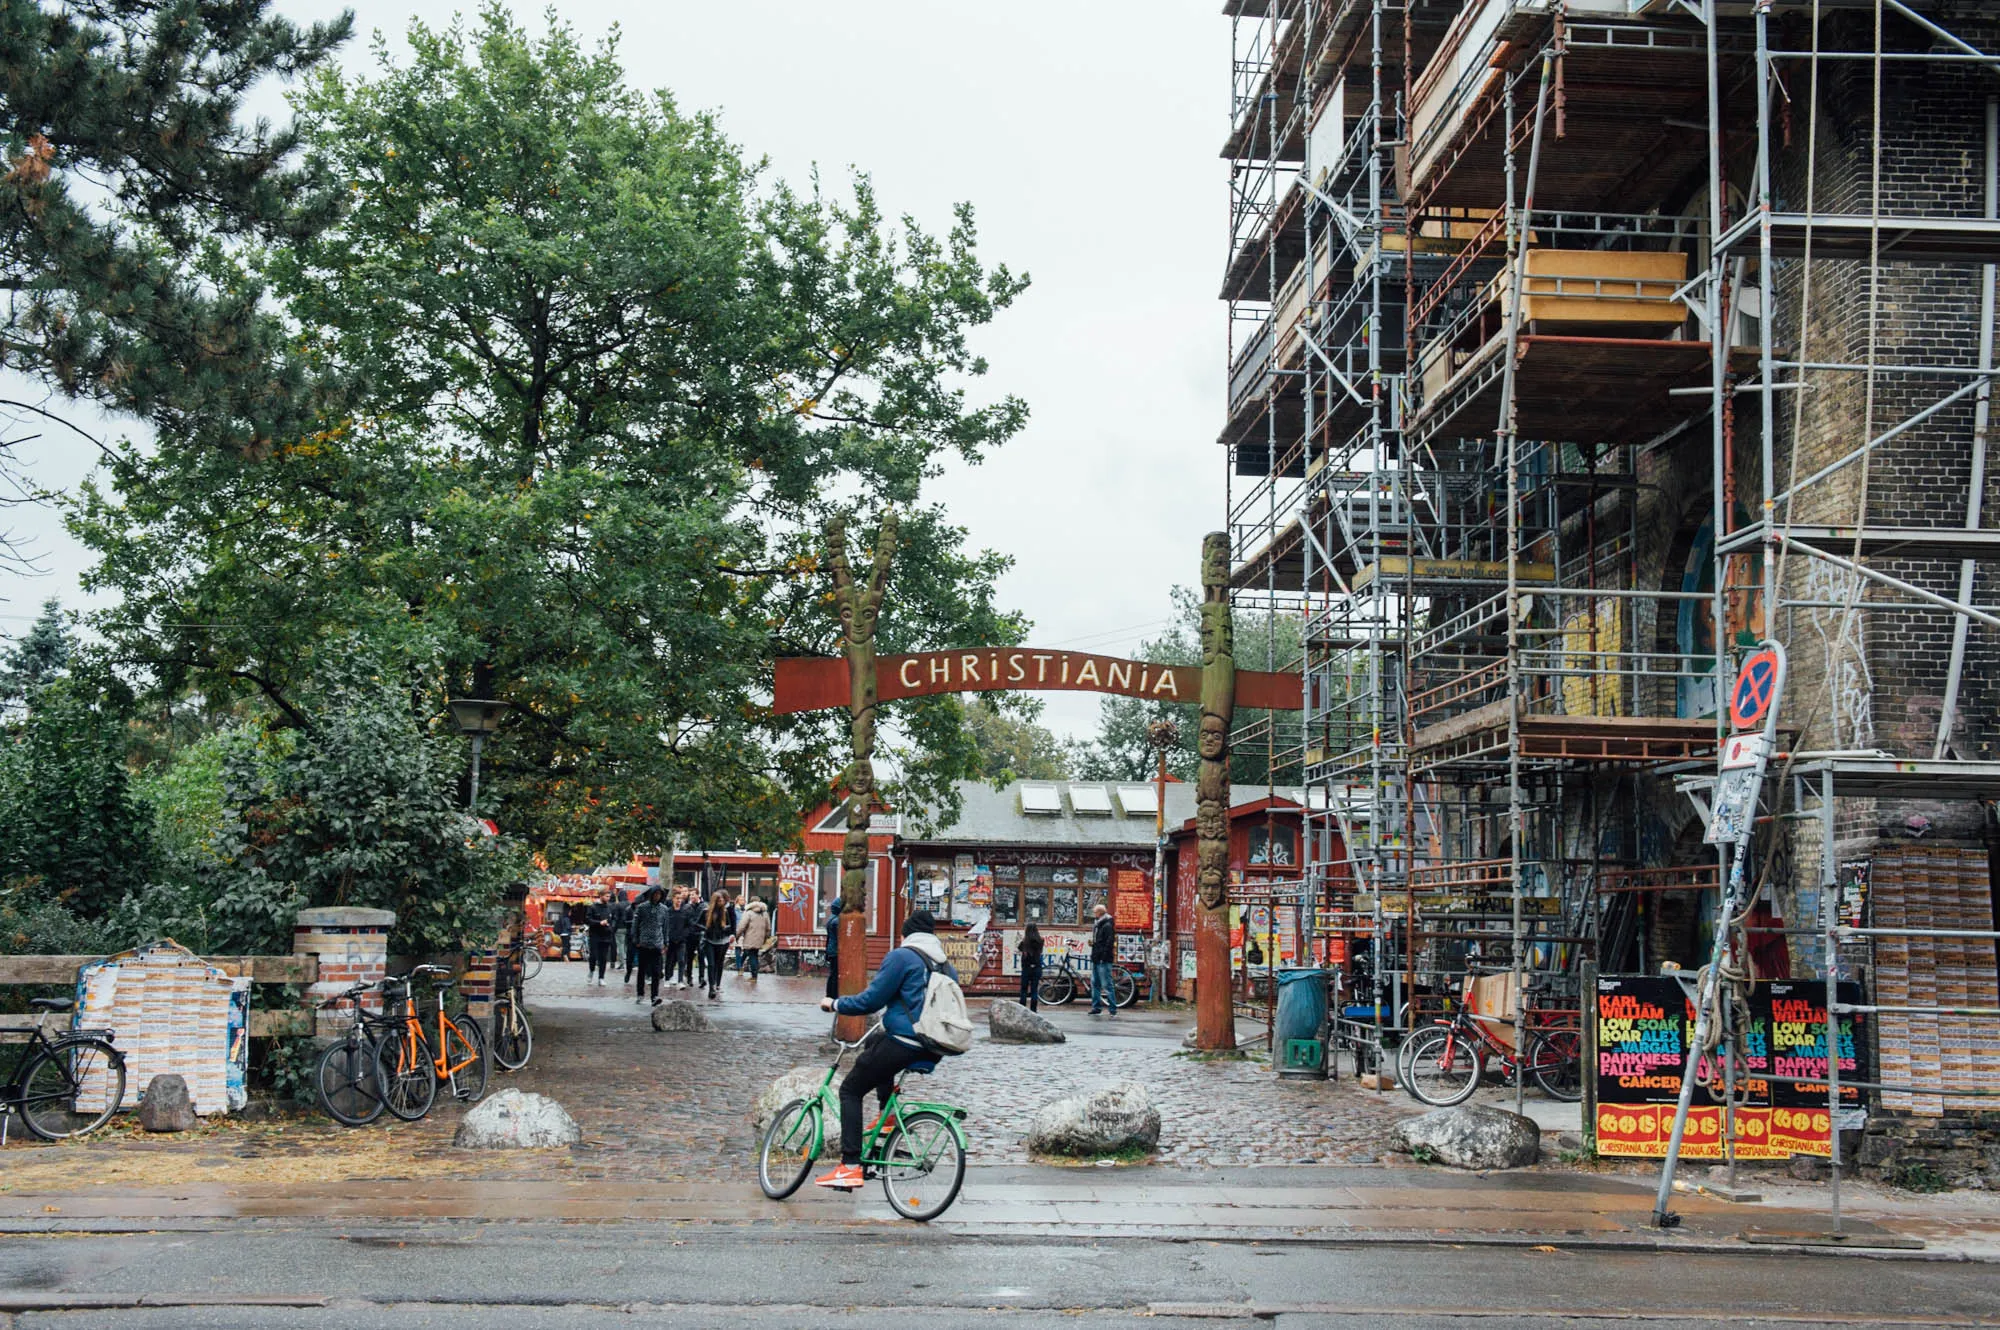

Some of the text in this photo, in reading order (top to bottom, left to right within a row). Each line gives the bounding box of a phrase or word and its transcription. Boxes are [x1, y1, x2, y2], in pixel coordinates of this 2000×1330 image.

[1600, 995, 1640, 1007] KARL
[1772, 1000, 1811, 1012] KARL
[1601, 1007, 1664, 1019] WILLIAM
[1600, 1018, 1679, 1031] LOW SOAK
[1773, 1022, 1806, 1034] LOW
[1600, 1030, 1641, 1042] ROAR
[1641, 1031, 1680, 1043] ALEX
[1774, 1034, 1815, 1046] ROAR
[1620, 1042, 1681, 1054] VARGAS
[1600, 1053, 1681, 1066] DARKNESS
[1601, 1065, 1645, 1076] FALLS
[1619, 1076, 1681, 1088] CANCER
